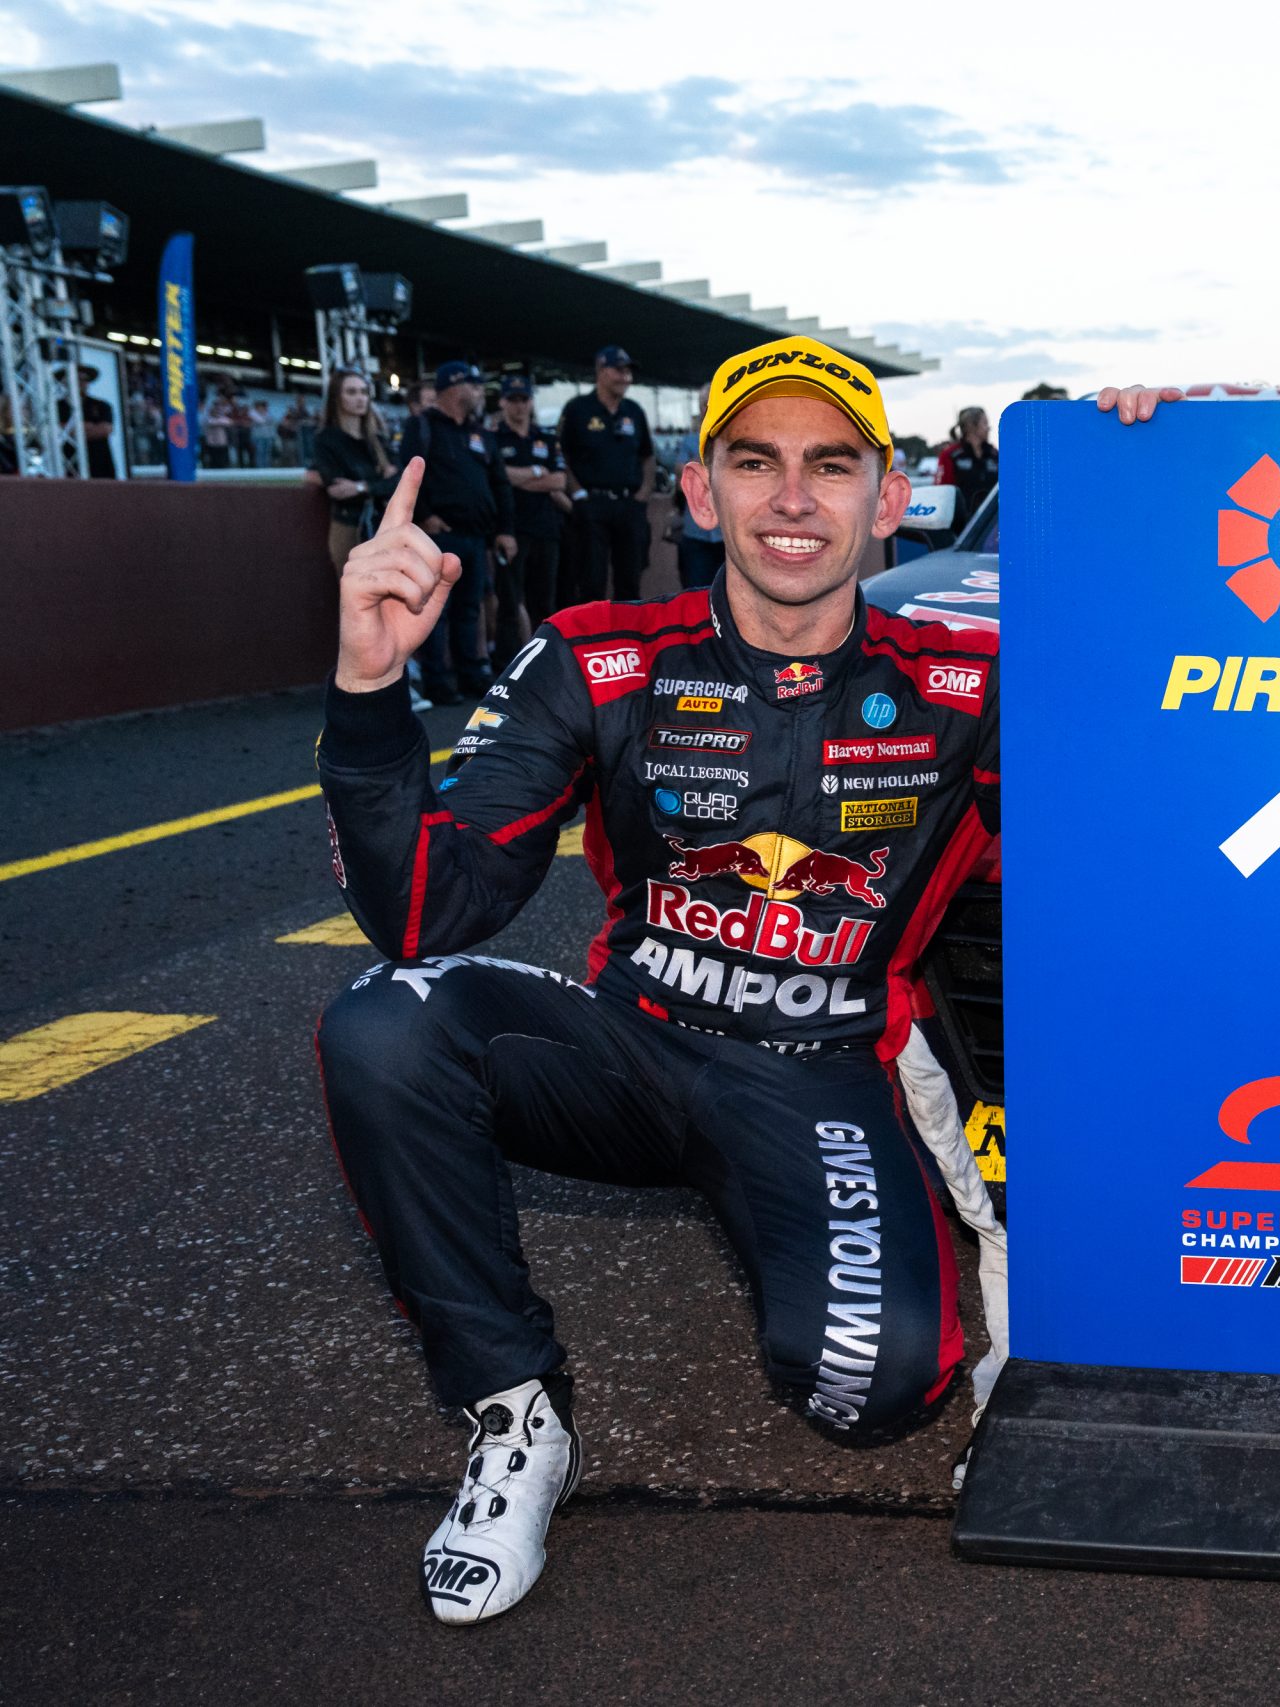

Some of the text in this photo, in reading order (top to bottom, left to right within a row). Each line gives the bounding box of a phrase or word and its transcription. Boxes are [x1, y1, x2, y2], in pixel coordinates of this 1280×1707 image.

[722, 351, 872, 394] DUNLOP
[587, 653, 641, 678] OMP
[653, 678, 749, 703] SUPERCHEAP
[928, 669, 981, 693] OMP
[683, 699, 718, 710] AUTO
[868, 693, 892, 728] hp
[828, 741, 931, 760] Harvey Norman
[645, 762, 750, 788] LOCAL LEGENDS
[843, 772, 940, 790] NEW HOLLAND
[684, 791, 738, 809] QUAD
[844, 800, 914, 815] NATIONAL
[684, 805, 739, 821] LOCK
[847, 813, 912, 828] STORAGE
[646, 877, 877, 967] Red Bull
[629, 936, 867, 1017] AMPOL
[808, 1120, 882, 1431] GIVES YOU WING
